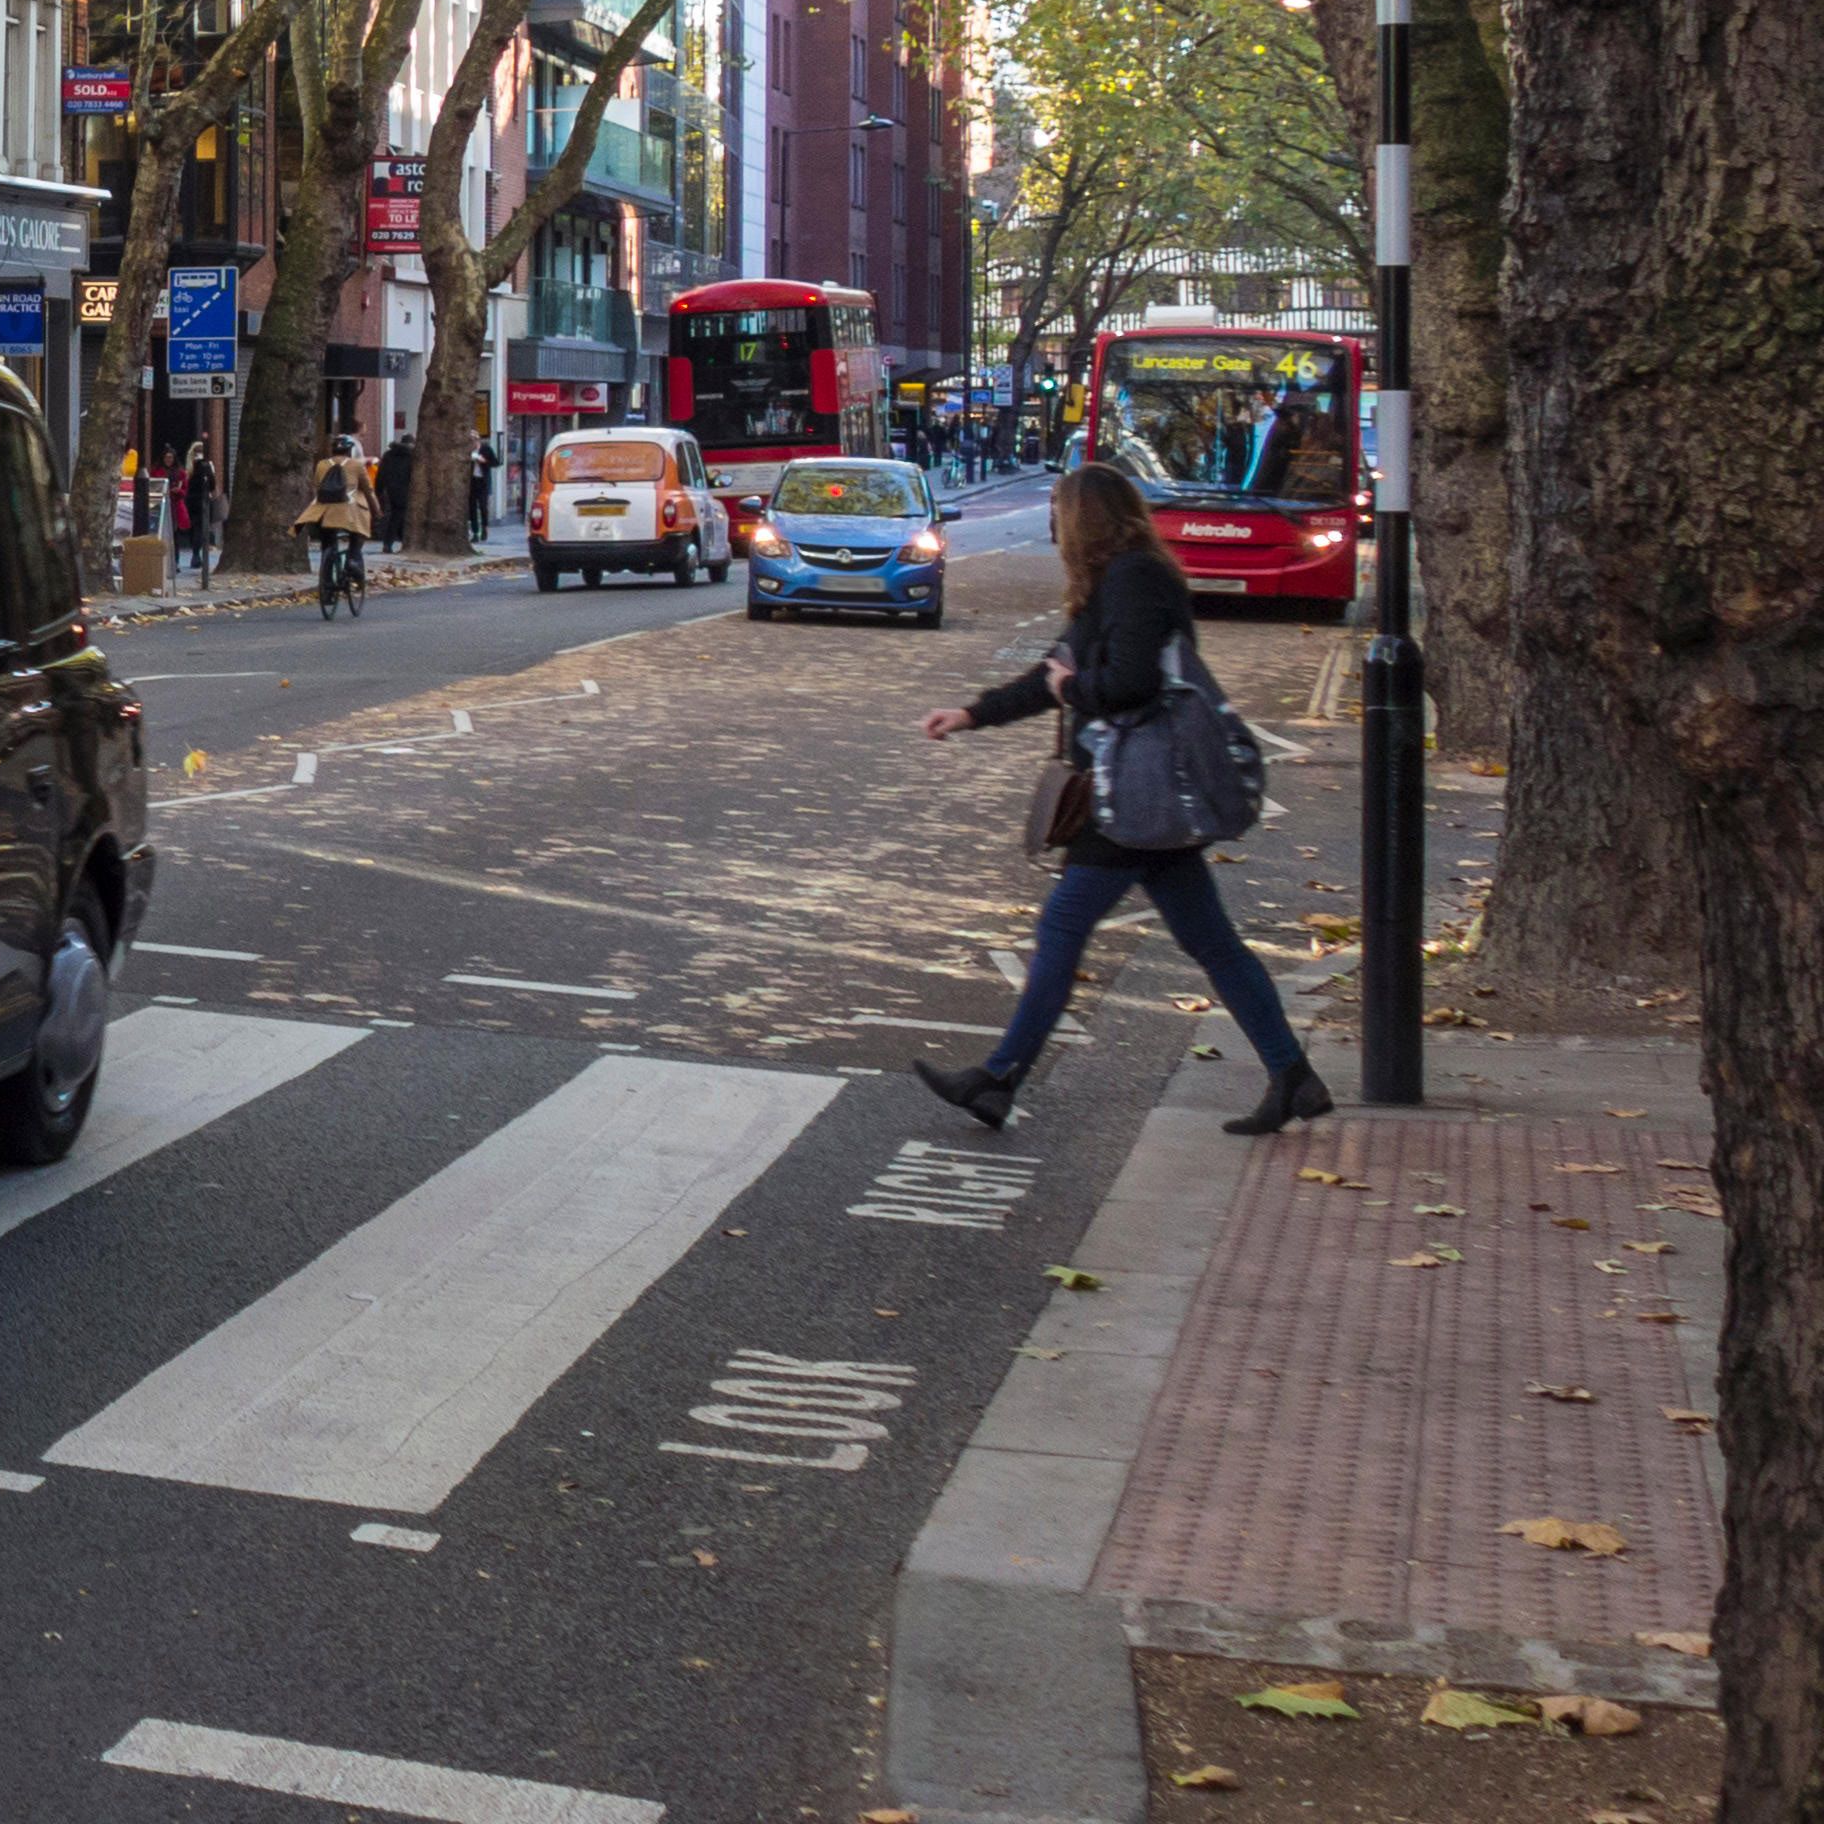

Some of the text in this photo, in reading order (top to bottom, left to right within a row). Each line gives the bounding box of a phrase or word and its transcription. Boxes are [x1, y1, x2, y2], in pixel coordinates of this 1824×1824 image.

[73, 84, 108, 96] SOLD
[389, 214, 402, 223] TO
[19, 218, 62, 251] GALORE
[12, 294, 42, 303] ROAD
[81, 302, 114, 317] GAL
[174, 305, 189, 313] taxi
[185, 342, 203, 350] Mon
[208, 342, 220, 350] Fri
[739, 342, 758, 361] 17
[1132, 351, 1317, 379] Lancaster Gate 46
[172, 377, 207, 385] Bus lane
[1181, 522, 1252, 538] Metroline
[658, 1140, 1043, 1471] LOOK RIGHT
